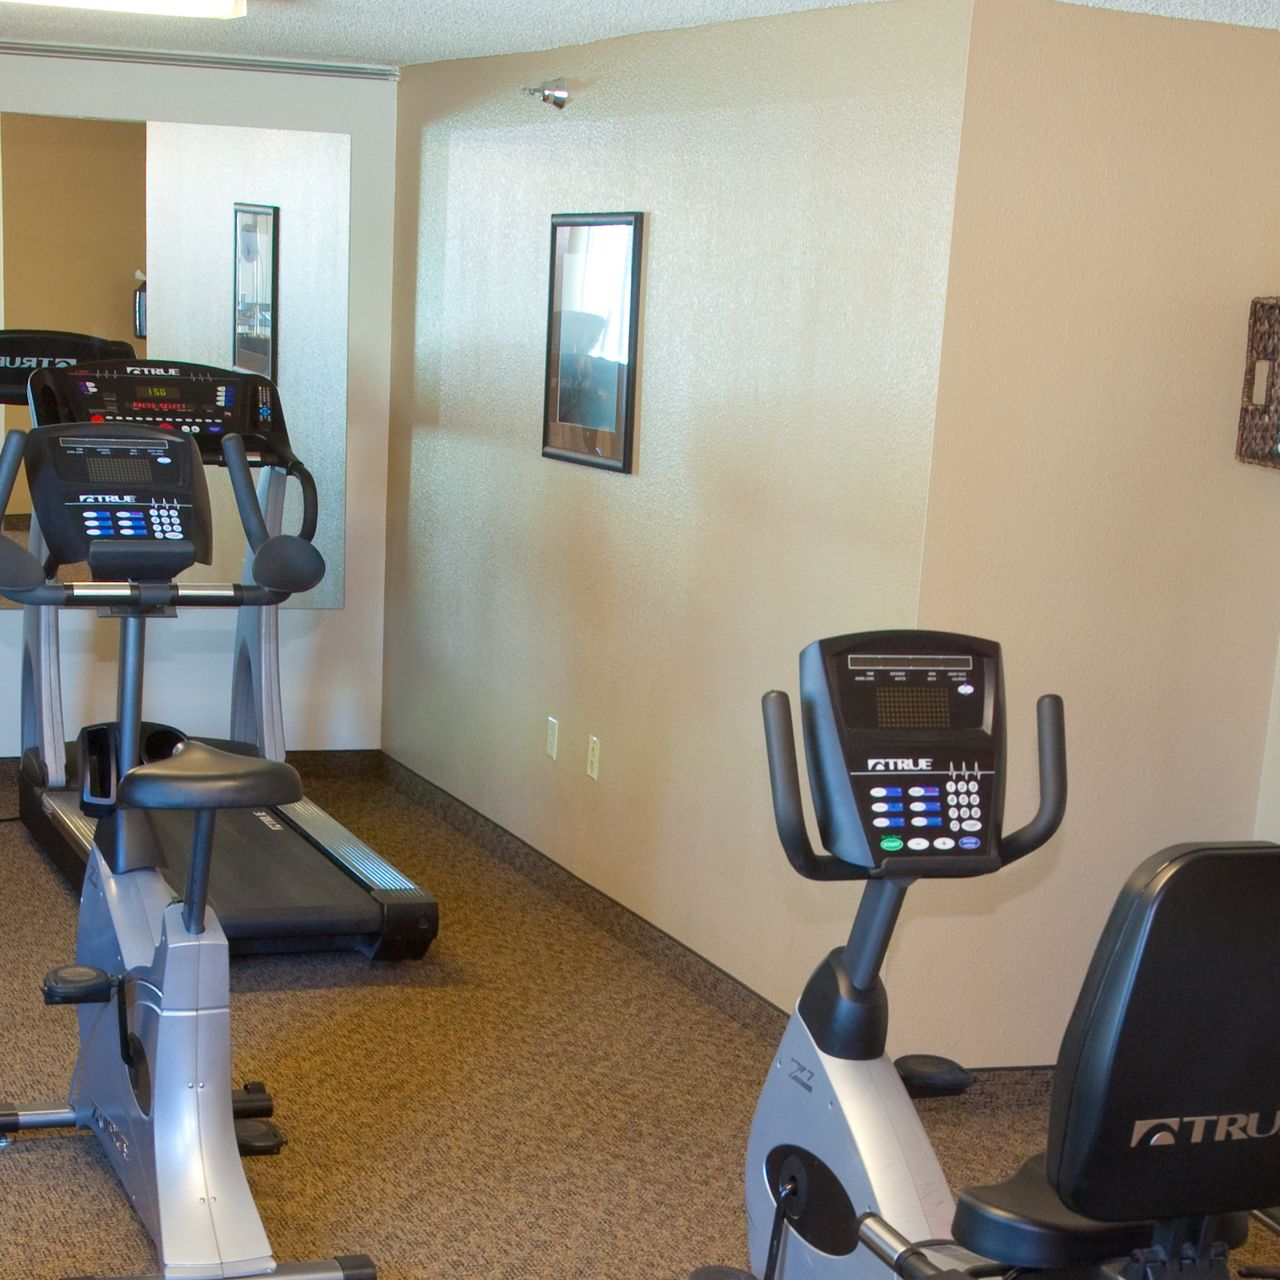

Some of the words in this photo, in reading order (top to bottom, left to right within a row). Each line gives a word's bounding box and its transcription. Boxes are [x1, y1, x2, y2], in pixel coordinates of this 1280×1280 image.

[141, 366, 181, 376] TRUE
[148, 387, 166, 396] 150
[93, 495, 136, 503] TRUE
[885, 759, 933, 771] TRUE
